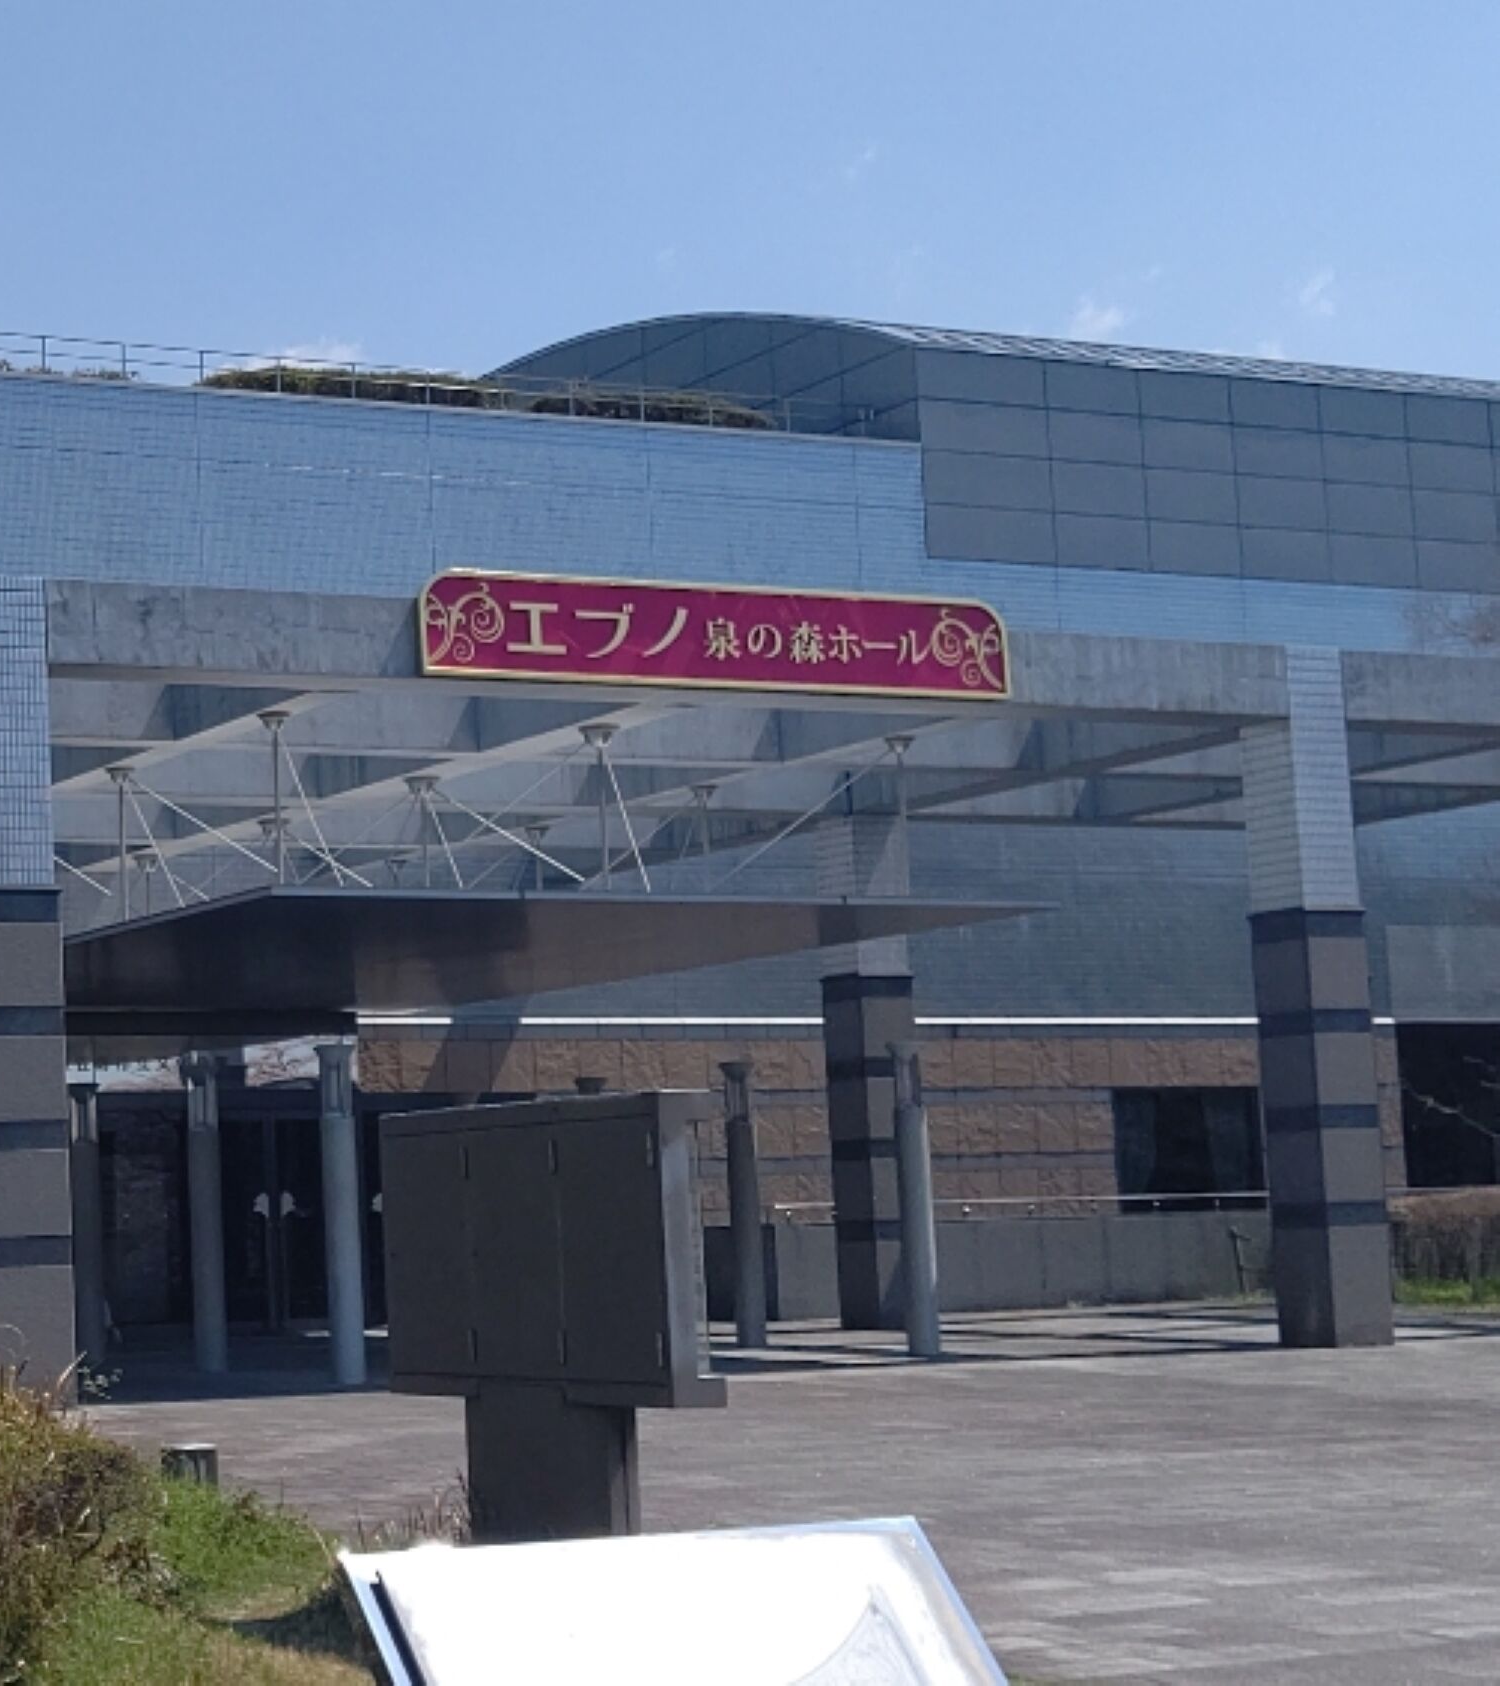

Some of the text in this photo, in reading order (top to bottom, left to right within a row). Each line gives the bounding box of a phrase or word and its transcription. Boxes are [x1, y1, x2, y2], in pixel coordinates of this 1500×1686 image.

[506, 602, 933, 665] エブノ 泉の森ホール
